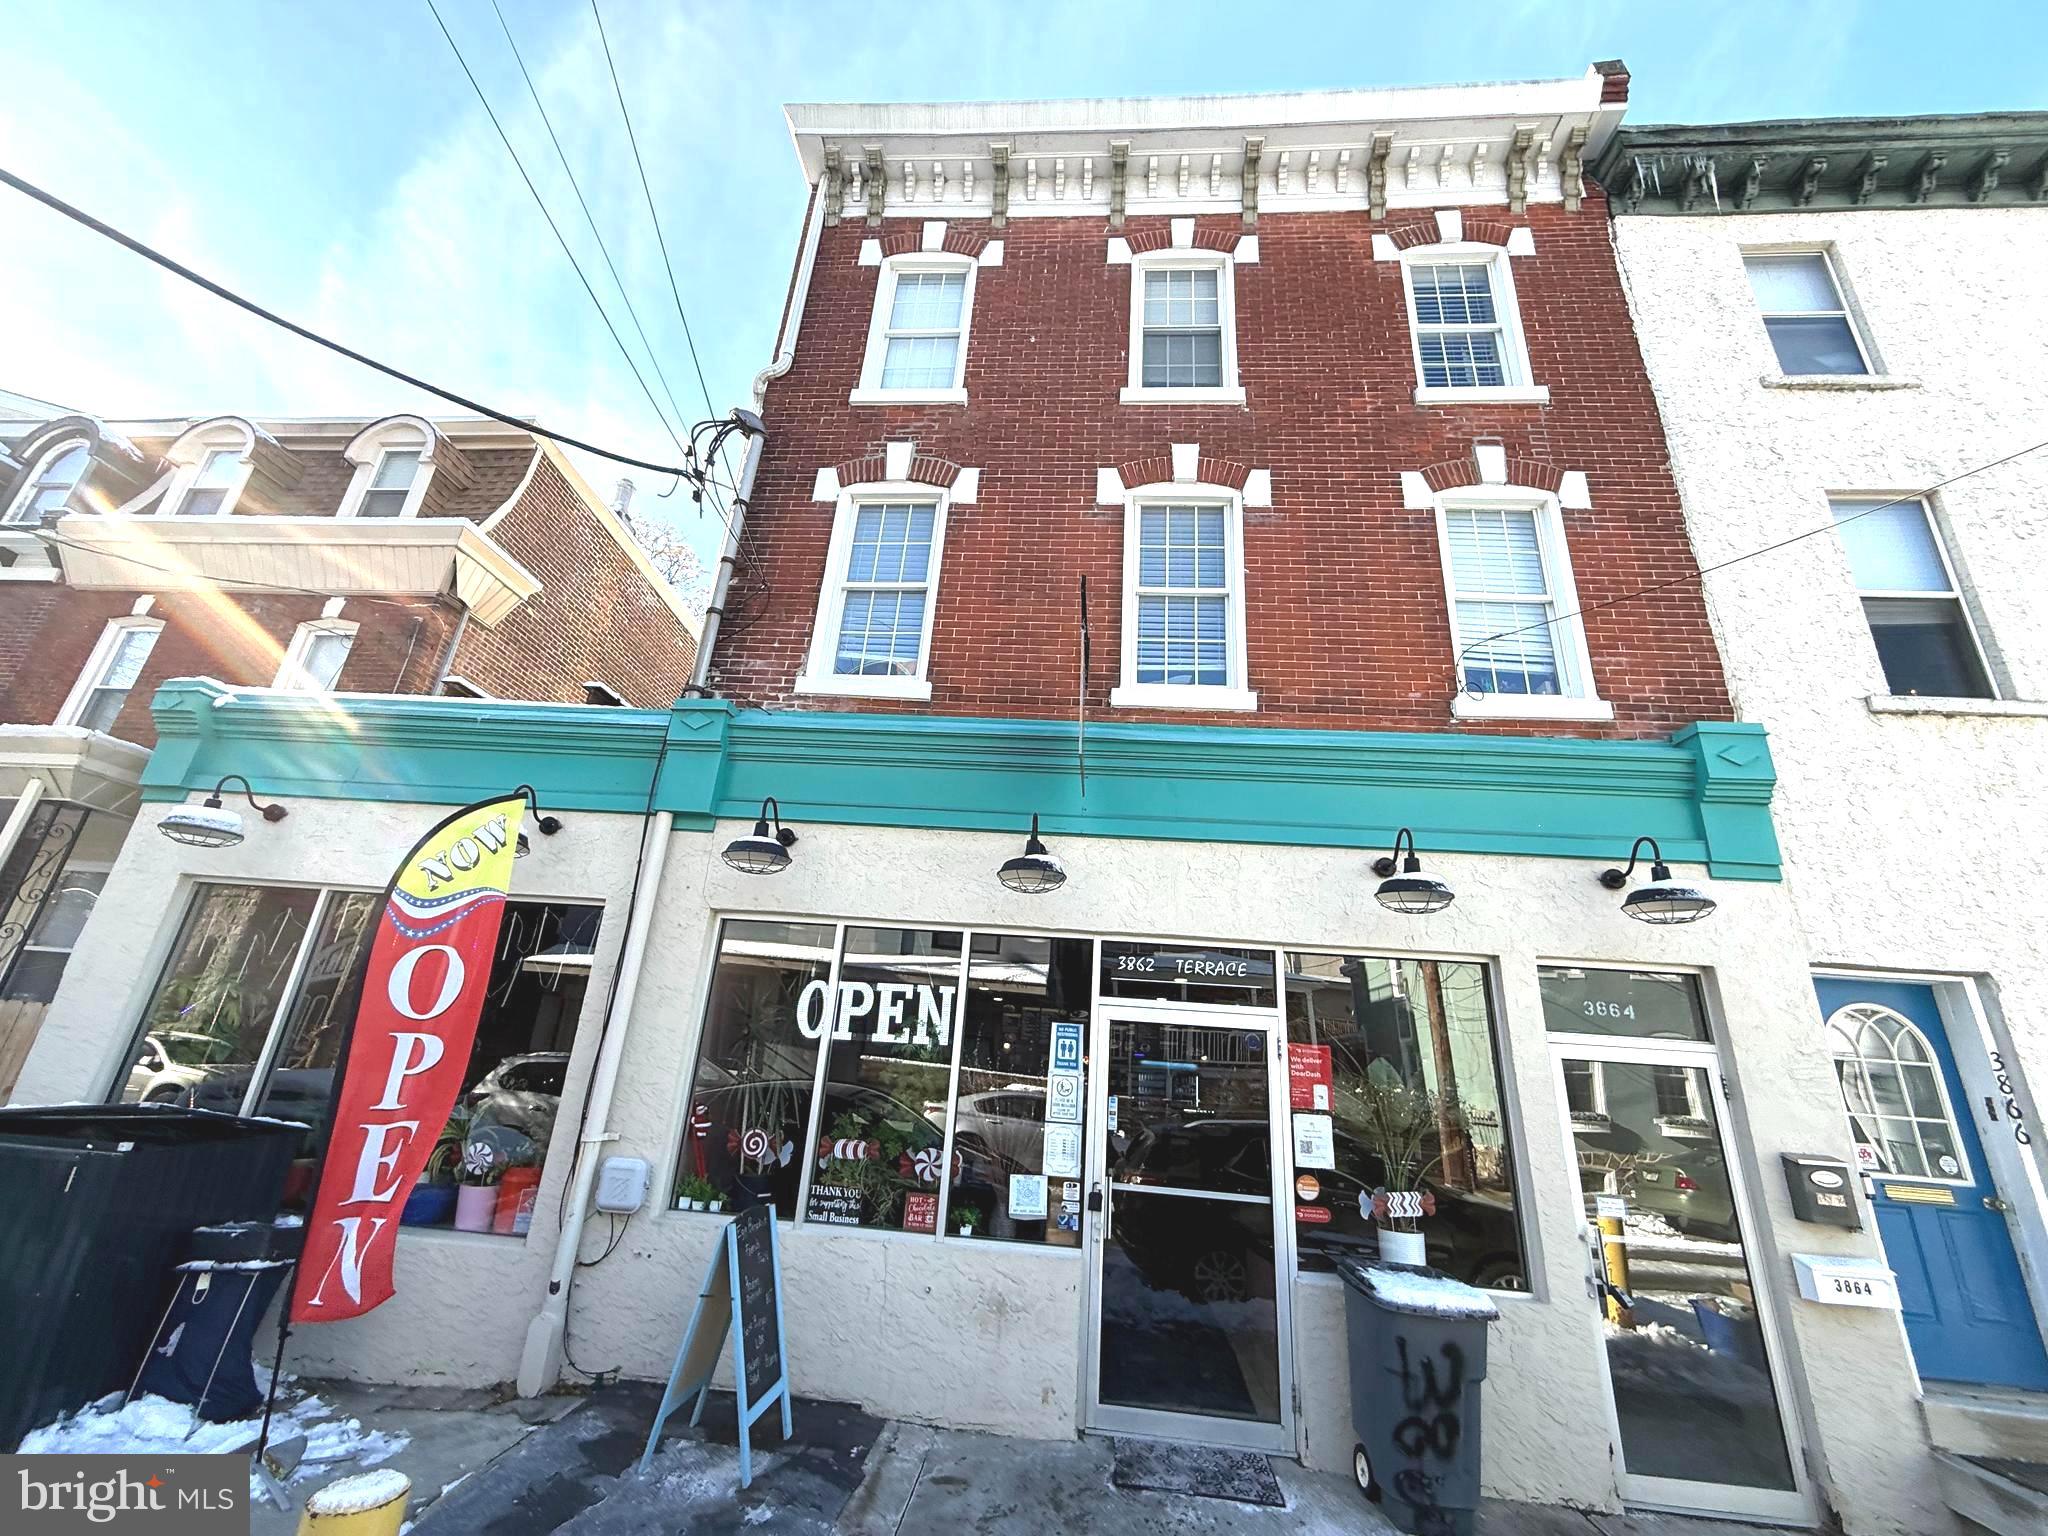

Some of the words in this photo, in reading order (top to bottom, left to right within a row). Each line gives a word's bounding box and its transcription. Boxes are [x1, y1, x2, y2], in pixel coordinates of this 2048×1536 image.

[417, 813, 509, 891] NOW
[1117, 955, 1156, 972] 3862
[1175, 959, 1248, 977] TERRACE
[796, 979, 956, 1046] OPEN
[1583, 1000, 1636, 1020] 3864
[1301, 1057, 1323, 1065] deliver
[1291, 1070, 1322, 1078] DoorDash
[307, 944, 466, 1306] OPEN
[810, 1184, 844, 1198] THANK
[843, 1187, 862, 1199] YOU
[908, 1203, 936, 1212] Chocolate
[808, 1209, 828, 1222] Small
[829, 1211, 860, 1225] Business
[908, 1213, 923, 1222] BAR
[1834, 1278, 1873, 1296] 3864
